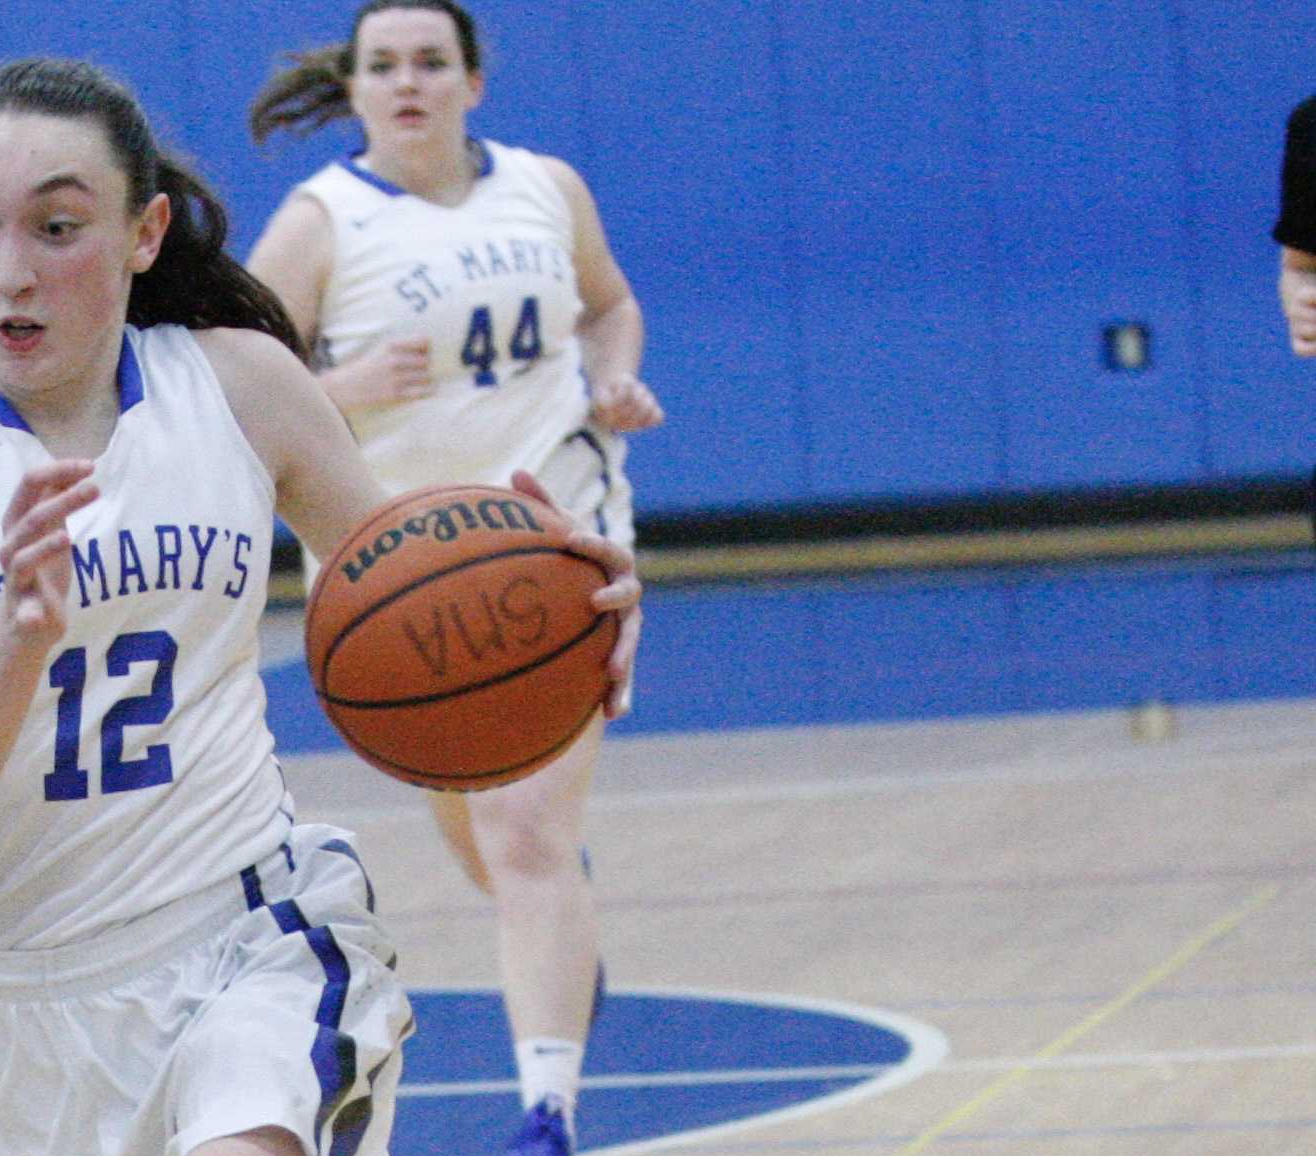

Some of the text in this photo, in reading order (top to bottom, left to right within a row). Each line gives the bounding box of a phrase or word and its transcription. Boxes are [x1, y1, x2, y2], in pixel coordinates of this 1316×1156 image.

[460, 296, 544, 388] 44
[71, 525, 253, 608] MARY'S
[340, 499, 545, 584] Wilson
[403, 576, 549, 678] SMA
[44, 629, 179, 802] 12
